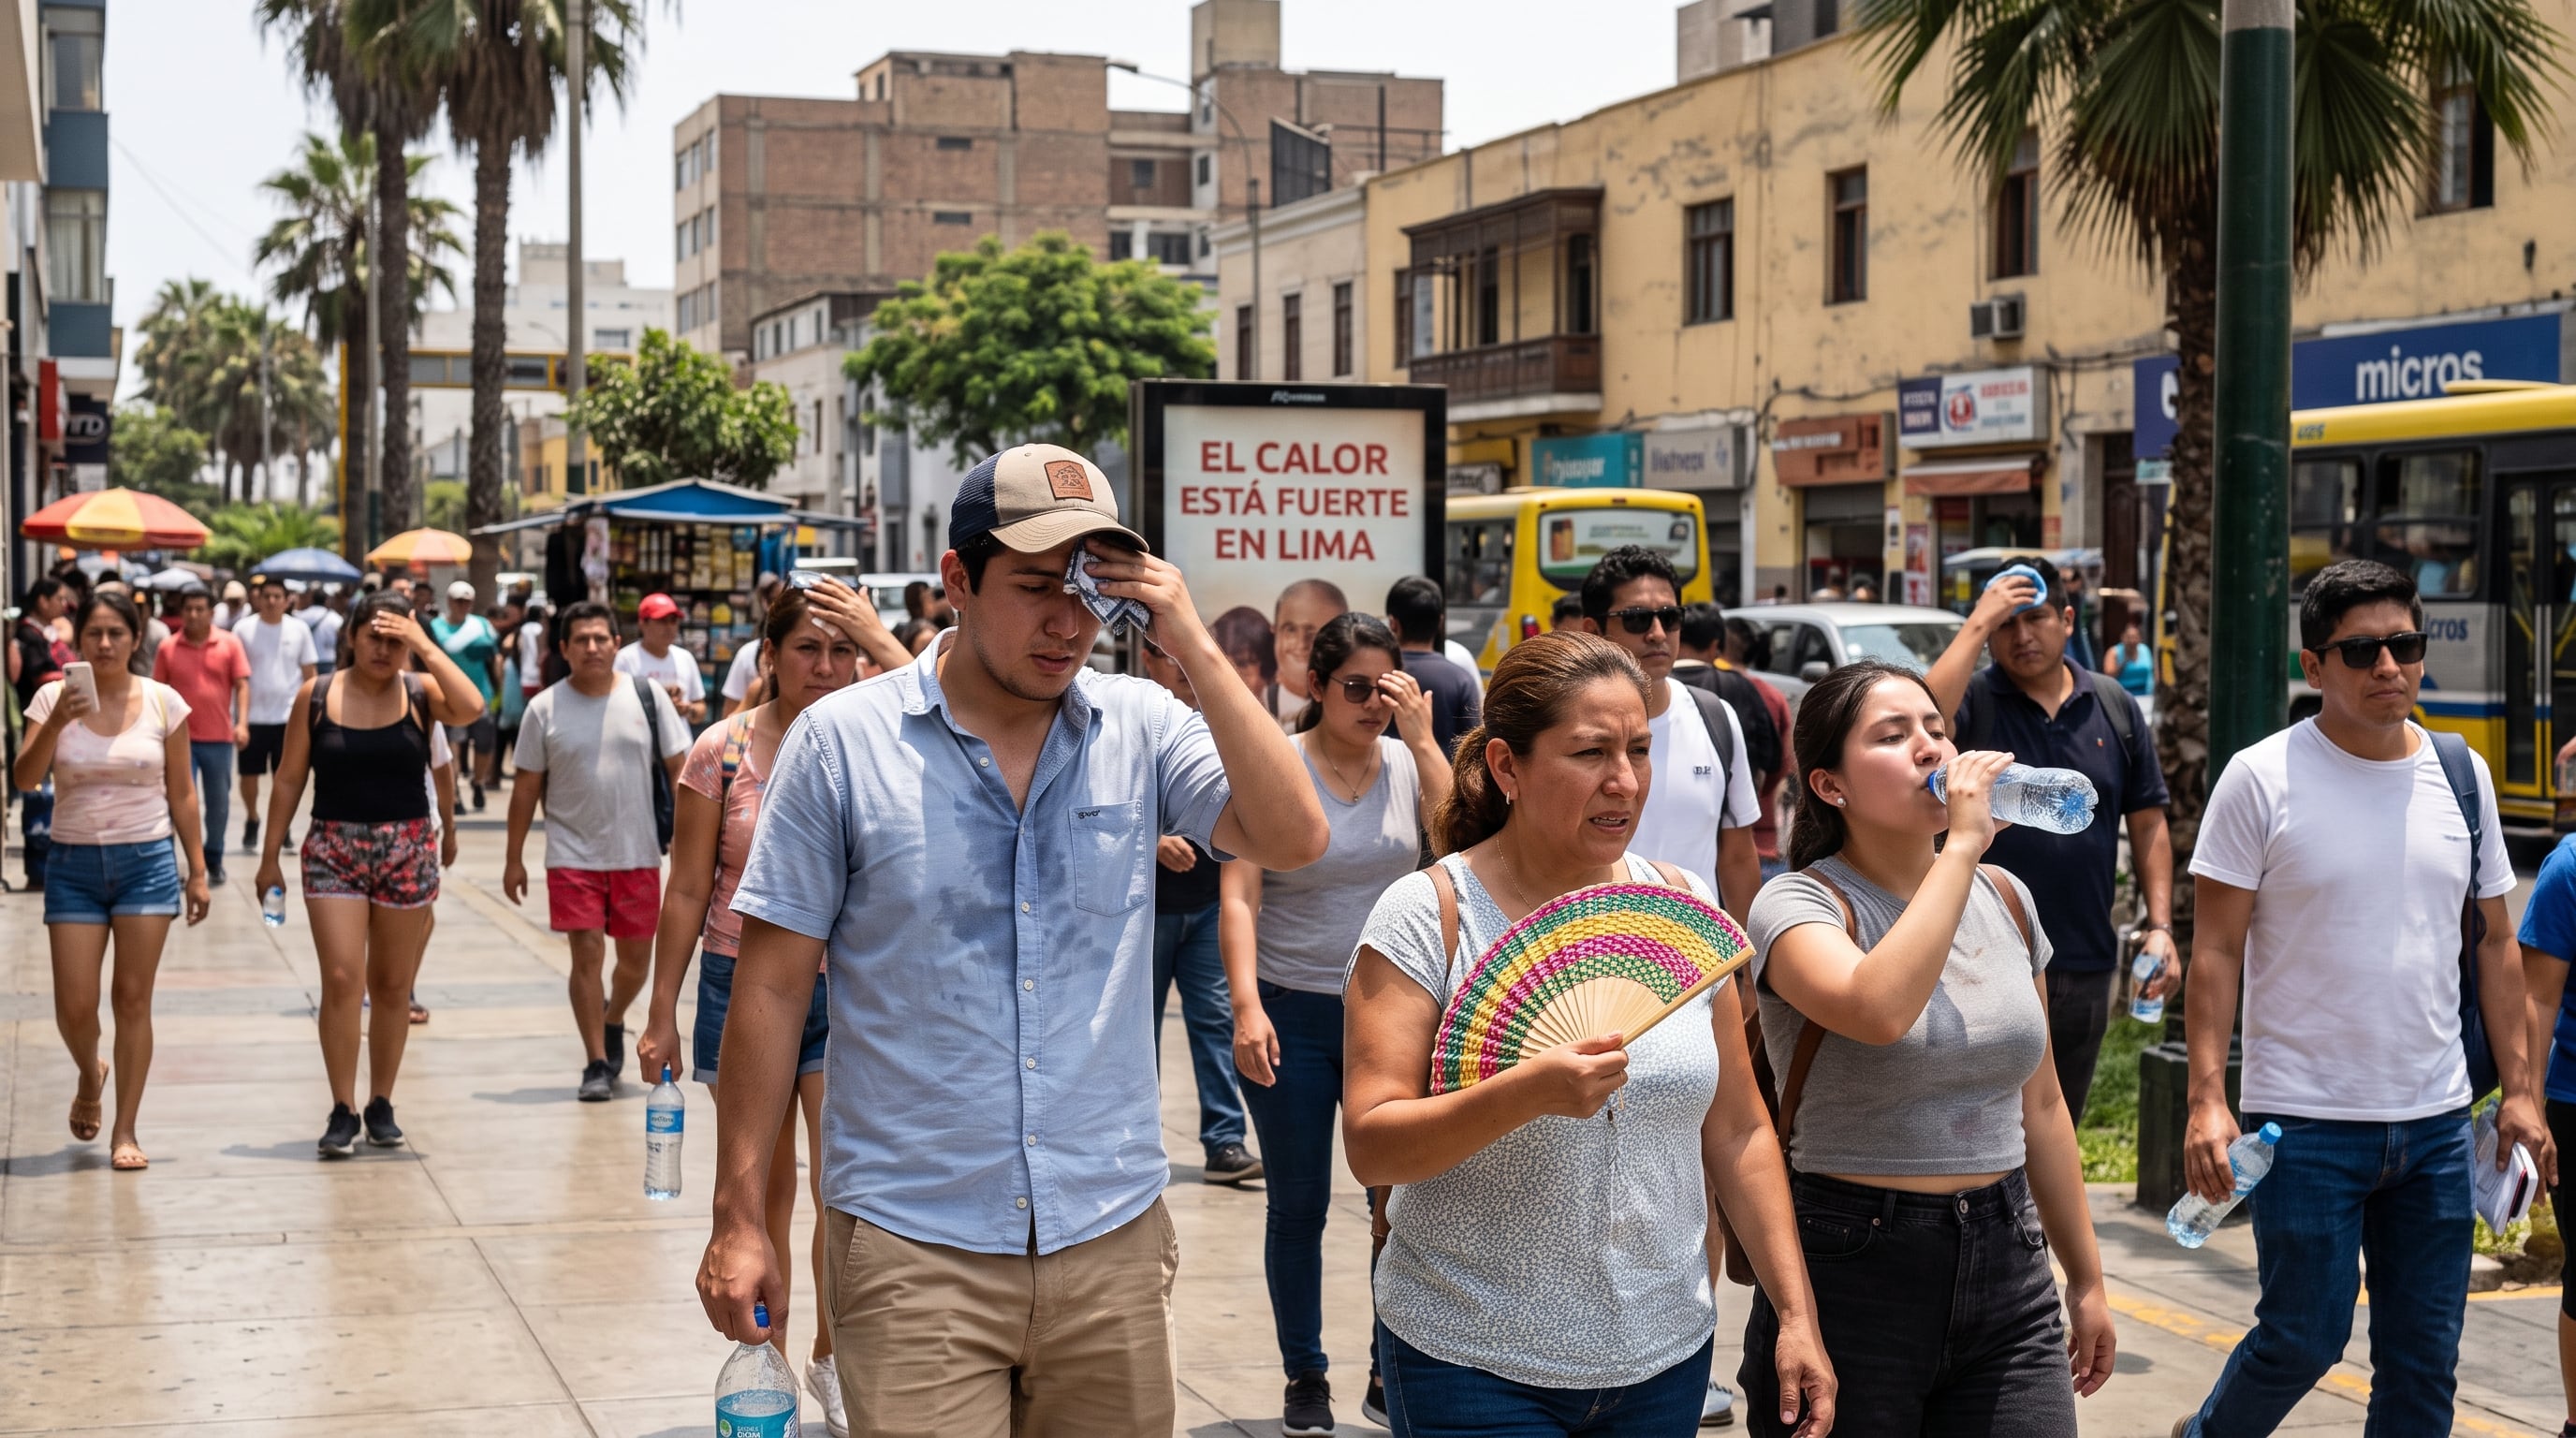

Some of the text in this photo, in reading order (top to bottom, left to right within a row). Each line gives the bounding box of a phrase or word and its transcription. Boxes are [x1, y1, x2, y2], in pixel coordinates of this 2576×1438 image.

[2356, 345, 2483, 401] micros
[1201, 441, 1388, 475] EL CALOR
[1181, 479, 1408, 517] ESTÁ FUERTE
[1216, 529, 1375, 561] EN LIMA
[2424, 613, 2469, 641] icros
